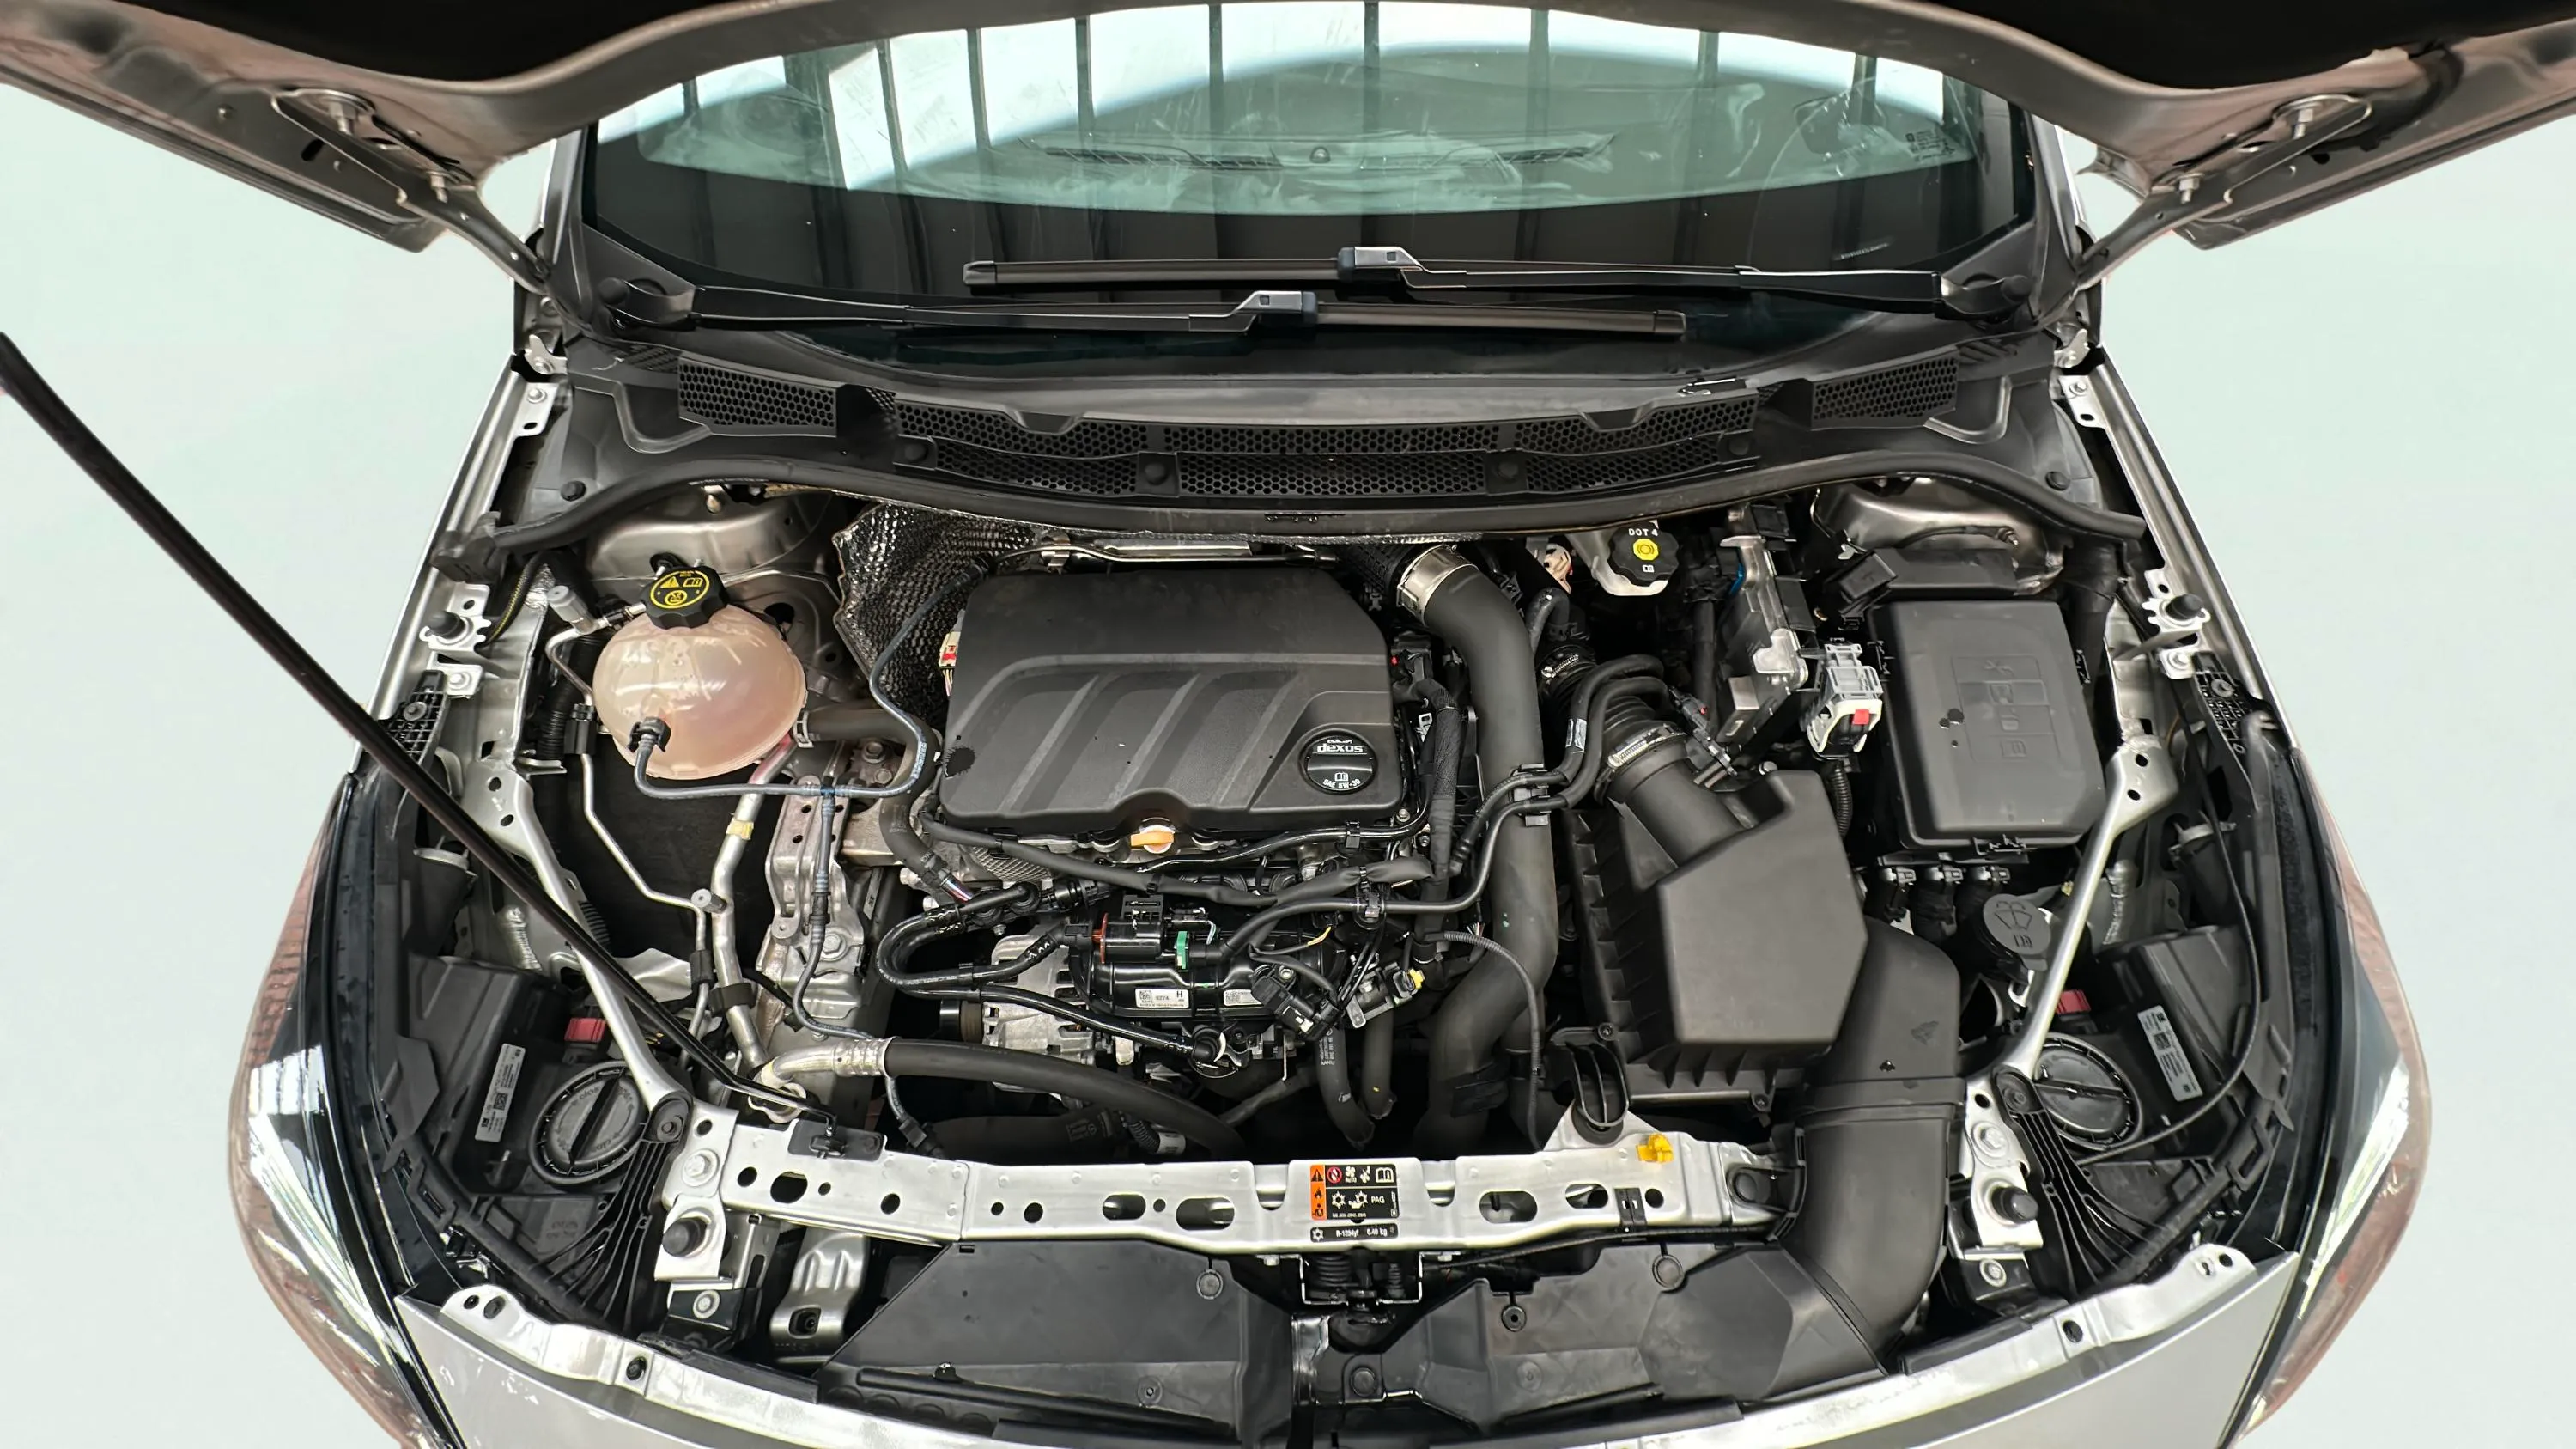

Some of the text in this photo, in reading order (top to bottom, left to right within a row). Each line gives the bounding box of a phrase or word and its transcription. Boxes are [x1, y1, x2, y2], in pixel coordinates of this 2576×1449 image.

[1316, 742, 1363, 752] dexos
[1322, 778, 1336, 788] SAE
[1371, 1196, 1385, 1204] PAG
[1380, 1227, 1388, 1237] kg
